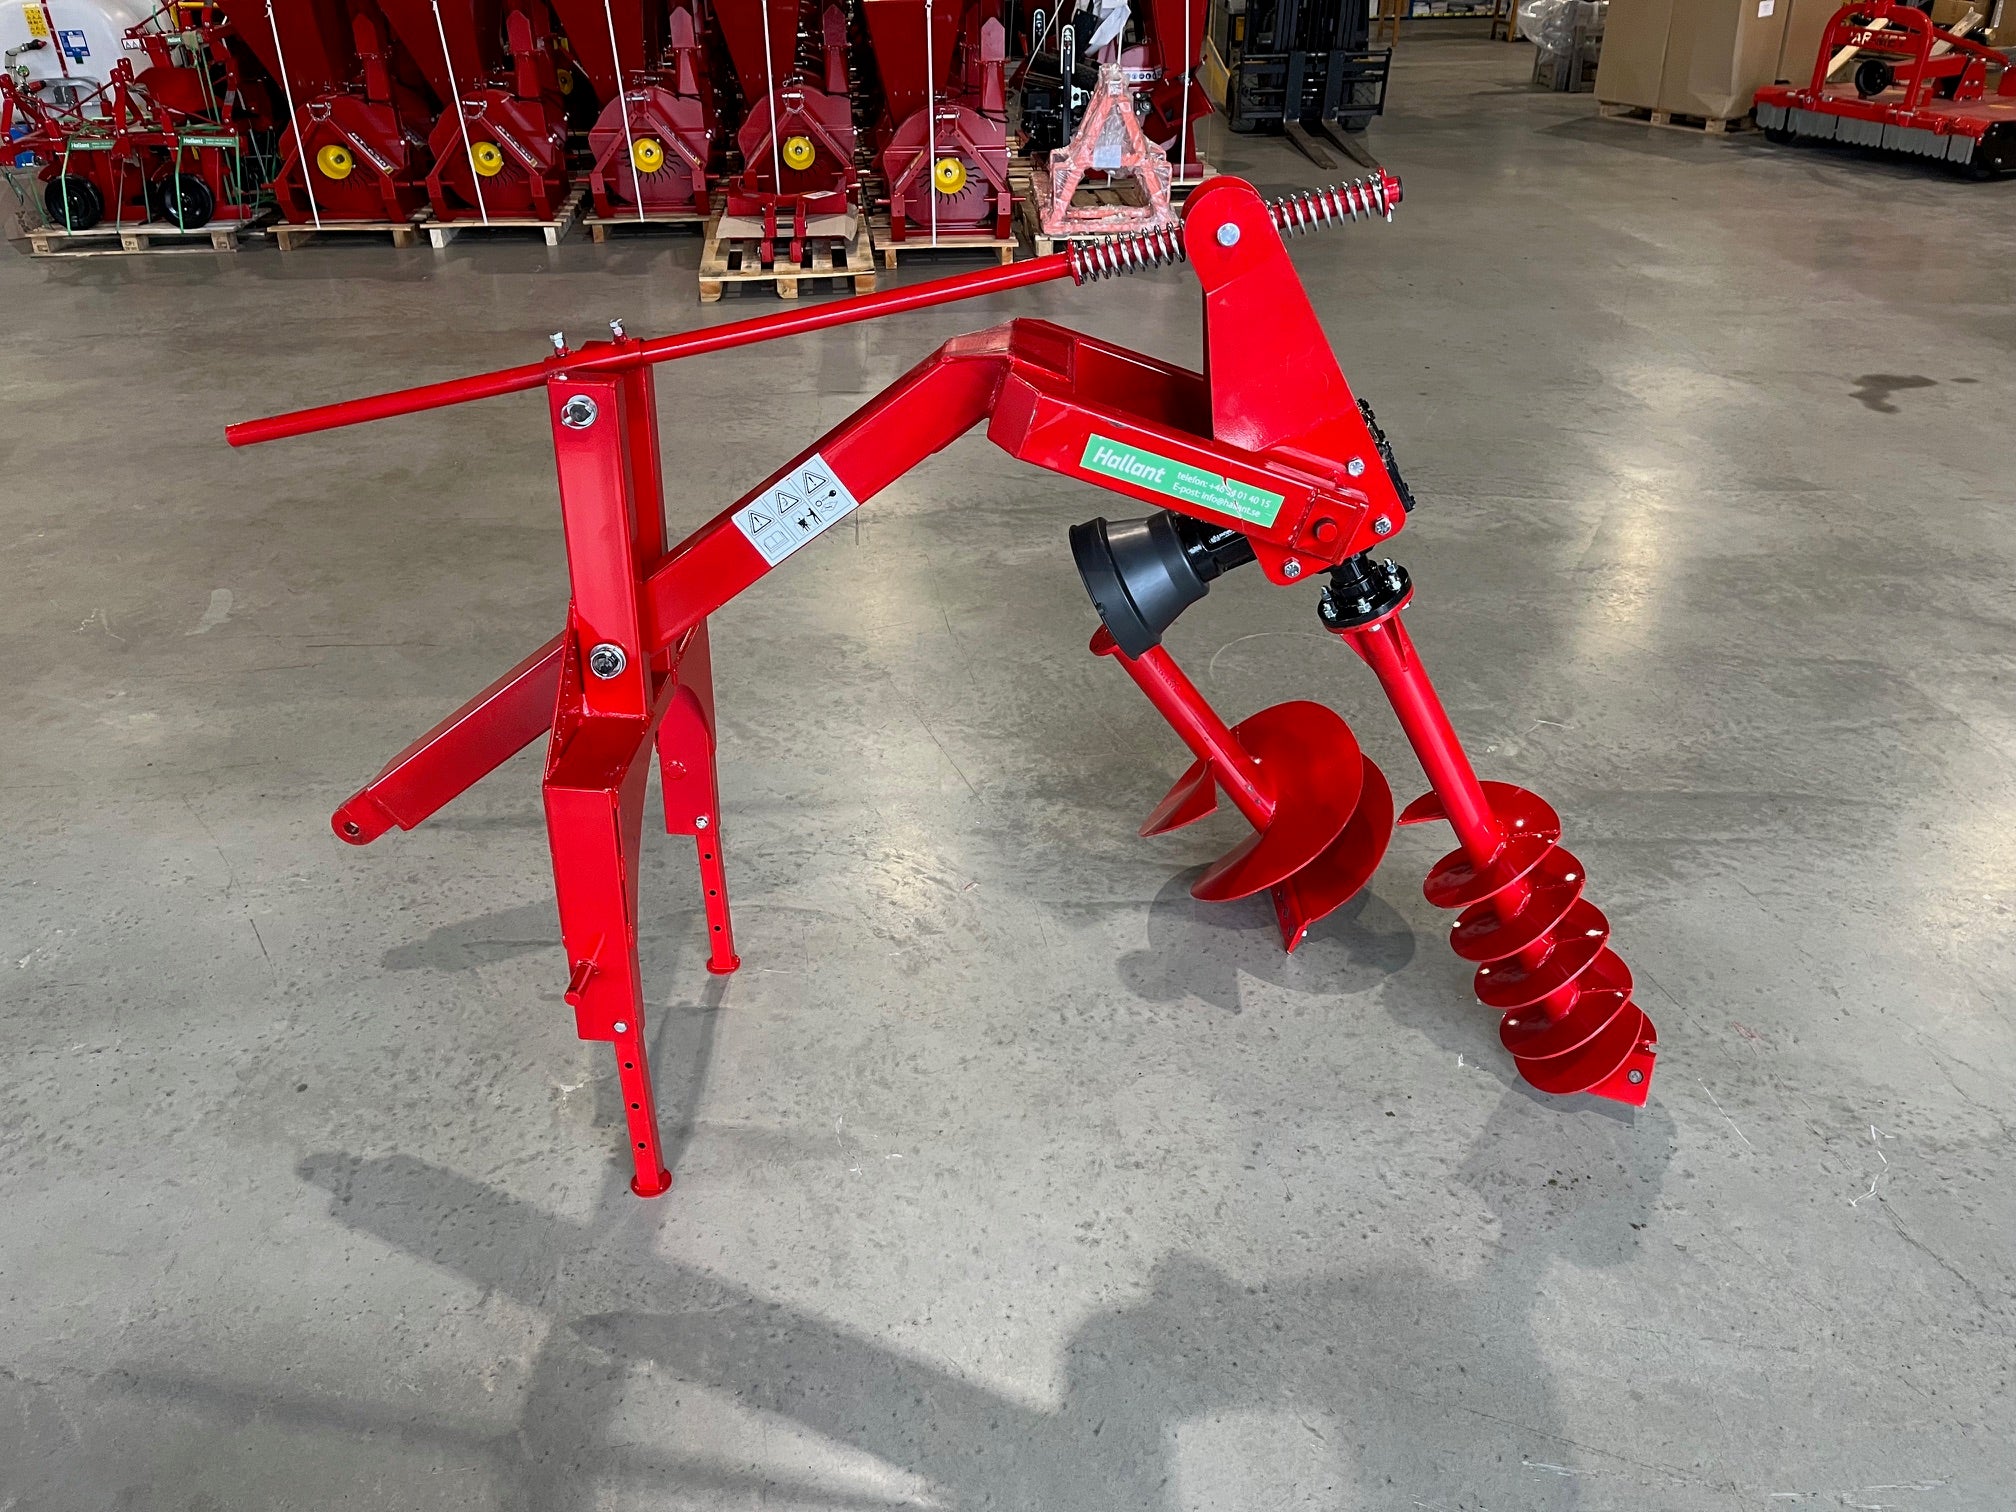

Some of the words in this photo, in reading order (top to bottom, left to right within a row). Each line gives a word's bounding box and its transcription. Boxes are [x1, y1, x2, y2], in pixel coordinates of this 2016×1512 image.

[1092, 446, 1166, 483] Hallant
[1172, 482, 1201, 498] E-post:
[1177, 471, 1208, 487] telefon:
[1208, 482, 1226, 494] +46
[1237, 491, 1248, 501] 01
[1248, 495, 1260, 505] 40
[1261, 498, 1272, 508] 15
